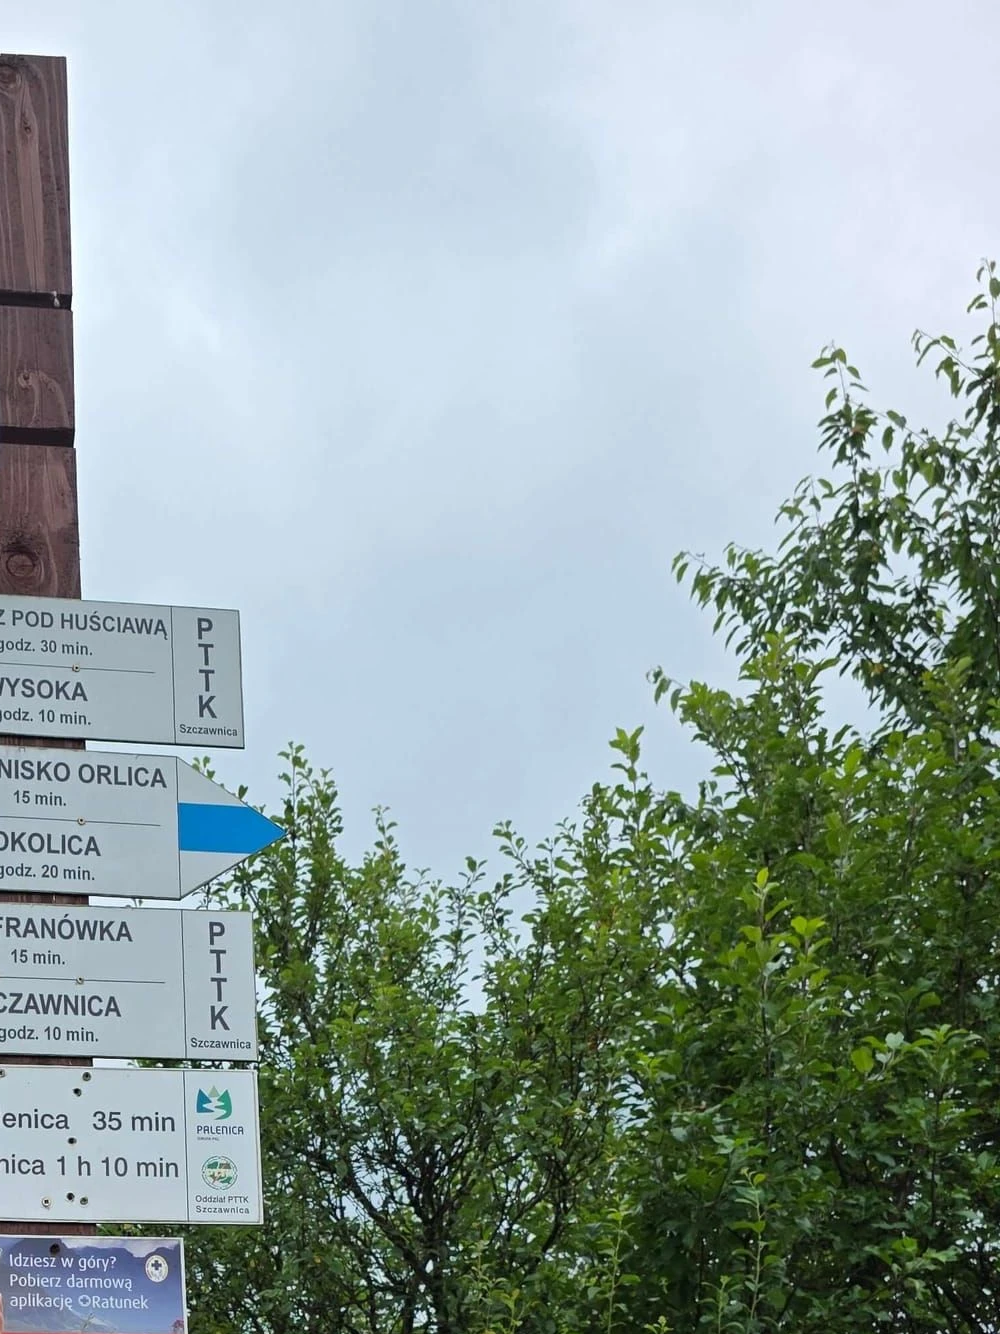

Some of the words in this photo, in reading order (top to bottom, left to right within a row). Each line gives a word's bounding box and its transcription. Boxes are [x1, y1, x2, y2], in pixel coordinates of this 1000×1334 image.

[11, 609, 54, 629] POD
[60, 610, 169, 641] HUŚCIAWĄ
[40, 639, 57, 654] 30
[61, 641, 94, 656] min.
[37, 709, 56, 723] 10
[59, 710, 92, 726] min.
[178, 723, 238, 737] Szczawnica
[77, 762, 167, 788] ORLICA
[12, 790, 31, 806] 15
[34, 790, 67, 807] min.
[41, 863, 59, 879] 20
[63, 864, 96, 881] min.
[10, 949, 29, 964] 15
[32, 949, 66, 965] min.
[44, 1026, 62, 1041] 10
[65, 1027, 99, 1043] min.
[190, 1036, 252, 1050] Szczawnica
[92, 1111, 123, 1131] 35
[131, 1111, 176, 1132] min
[196, 1125, 245, 1135] PALENICA
[56, 1156, 66, 1175] 1
[77, 1156, 91, 1176] h
[101, 1157, 129, 1177] 10
[136, 1158, 180, 1178] min
[195, 1195, 226, 1204] Oddział
[227, 1196, 250, 1204] PTTK
[195, 1205, 250, 1215] Szczawnica
[9, 1253, 57, 1269] Idziesz
[61, 1257, 73, 1268] w
[78, 1256, 117, 1272] góry?
[9, 1274, 62, 1288] Pobierz
[66, 1275, 133, 1292] darmową
[9, 1293, 73, 1311] aplikację
[92, 1294, 149, 1310] Ratunek
